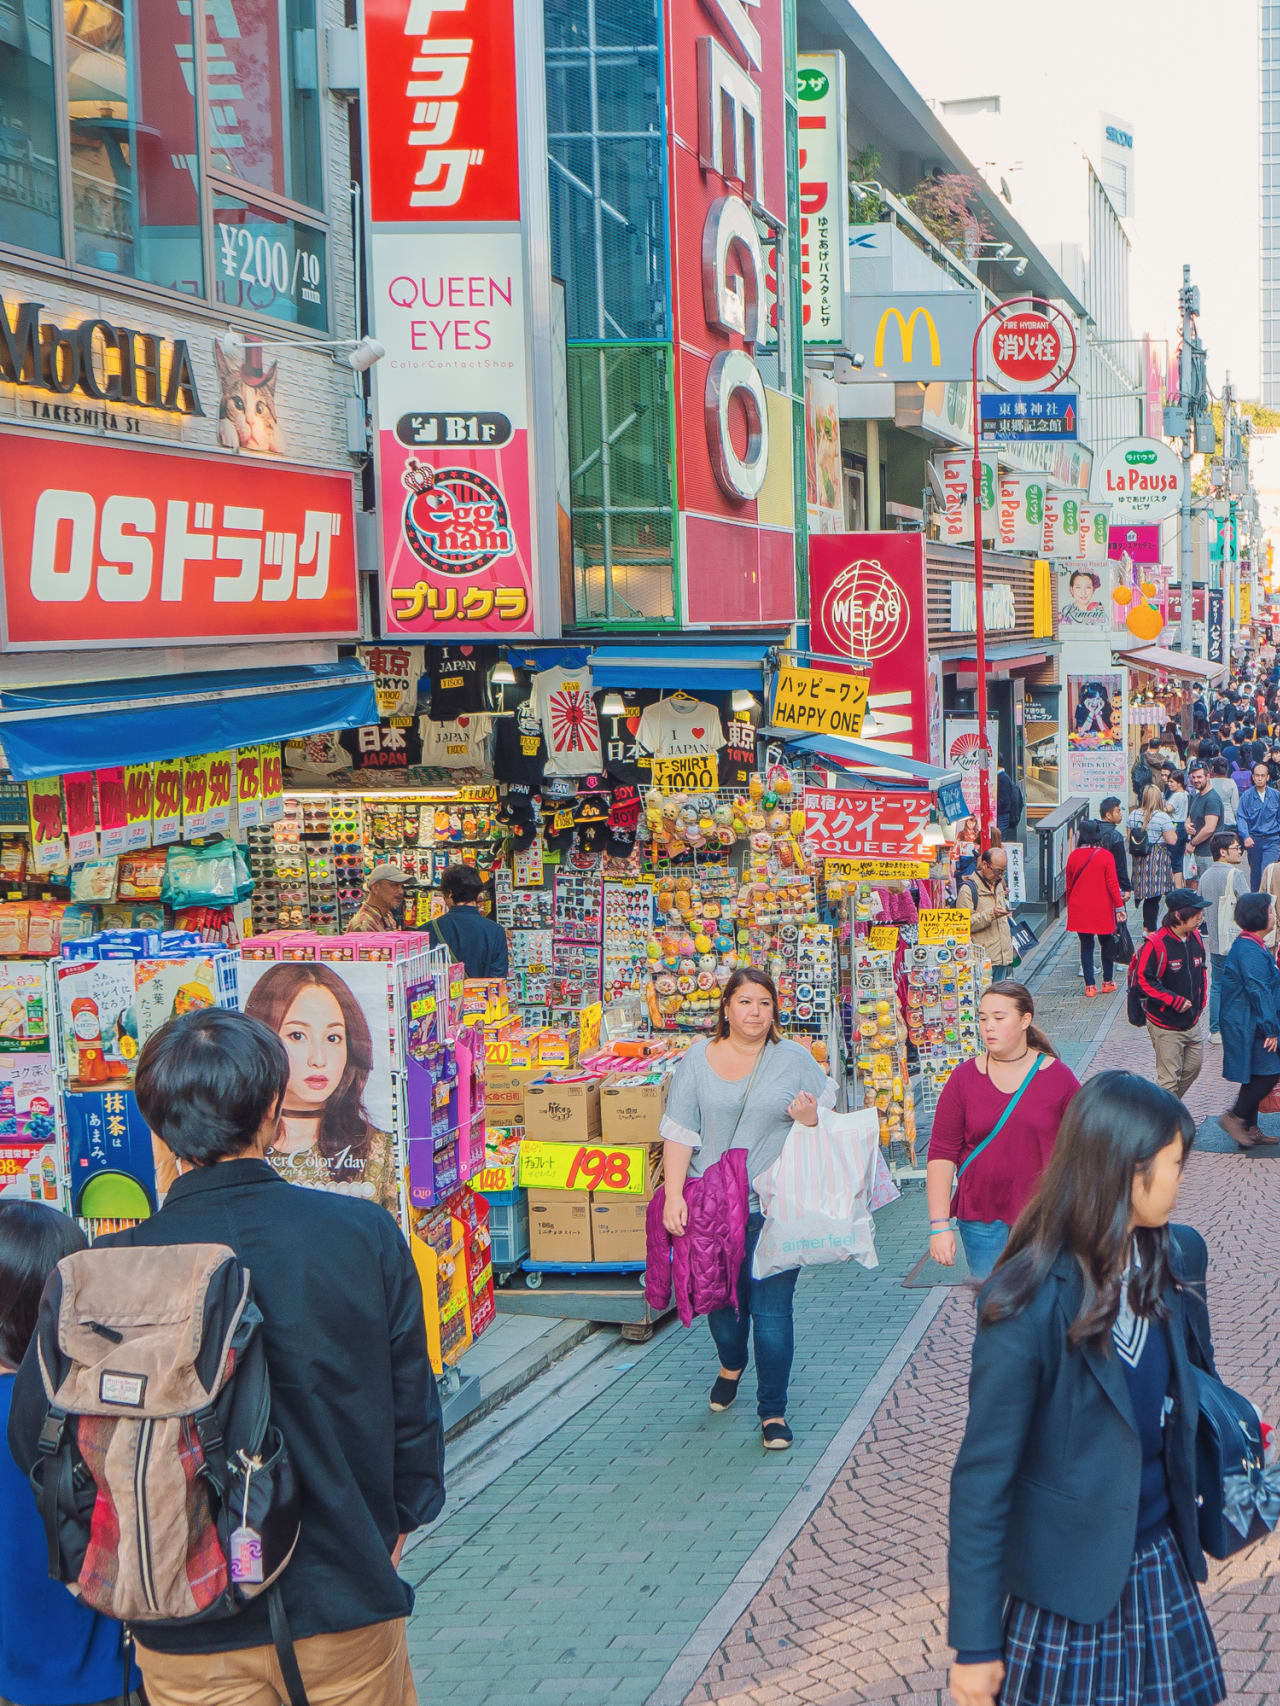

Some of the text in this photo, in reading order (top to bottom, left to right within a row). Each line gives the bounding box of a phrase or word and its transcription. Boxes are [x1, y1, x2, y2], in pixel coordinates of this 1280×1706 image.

[388, 276, 513, 309] QUEEN
[409, 320, 492, 351] EYES
[1003, 321, 1049, 329] FIRE HYDRANT
[998, 333, 1056, 361] 消火栓
[999, 402, 1059, 416] 東郷神社
[999, 419, 1062, 432] 東郷記念館
[1107, 469, 1177, 492] La Pausa
[412, 486, 496, 534] egg
[1001, 480, 1020, 544] La Pausa
[30, 488, 341, 603] OSドラッグ
[437, 529, 509, 551] nam
[365, 647, 411, 677] 東京
[439, 660, 477, 673] JAPAN
[376, 677, 409, 690] OKYO
[781, 676, 865, 704] ハッピーワン
[776, 702, 862, 733] HAPPY ONE
[358, 727, 407, 751] 日本
[727, 719, 755, 750] 東京
[360, 752, 407, 768] JAPAN
[668, 743, 712, 755] JAPAN
[656, 758, 709, 772] T-SHIRT
[655, 770, 713, 791] ¥1000
[614, 786, 635, 800] BOY
[804, 793, 933, 813] 原宿ハッピーワン
[614, 809, 636, 825] BOY
[805, 839, 933, 856] SQUEEZE
[151, 978, 165, 1007] 茶葉
[104, 1092, 127, 1149] 抹茶は
[479, 1169, 508, 1190] 148
[566, 1147, 631, 1191] 198
[782, 1231, 857, 1253] aimer feel
